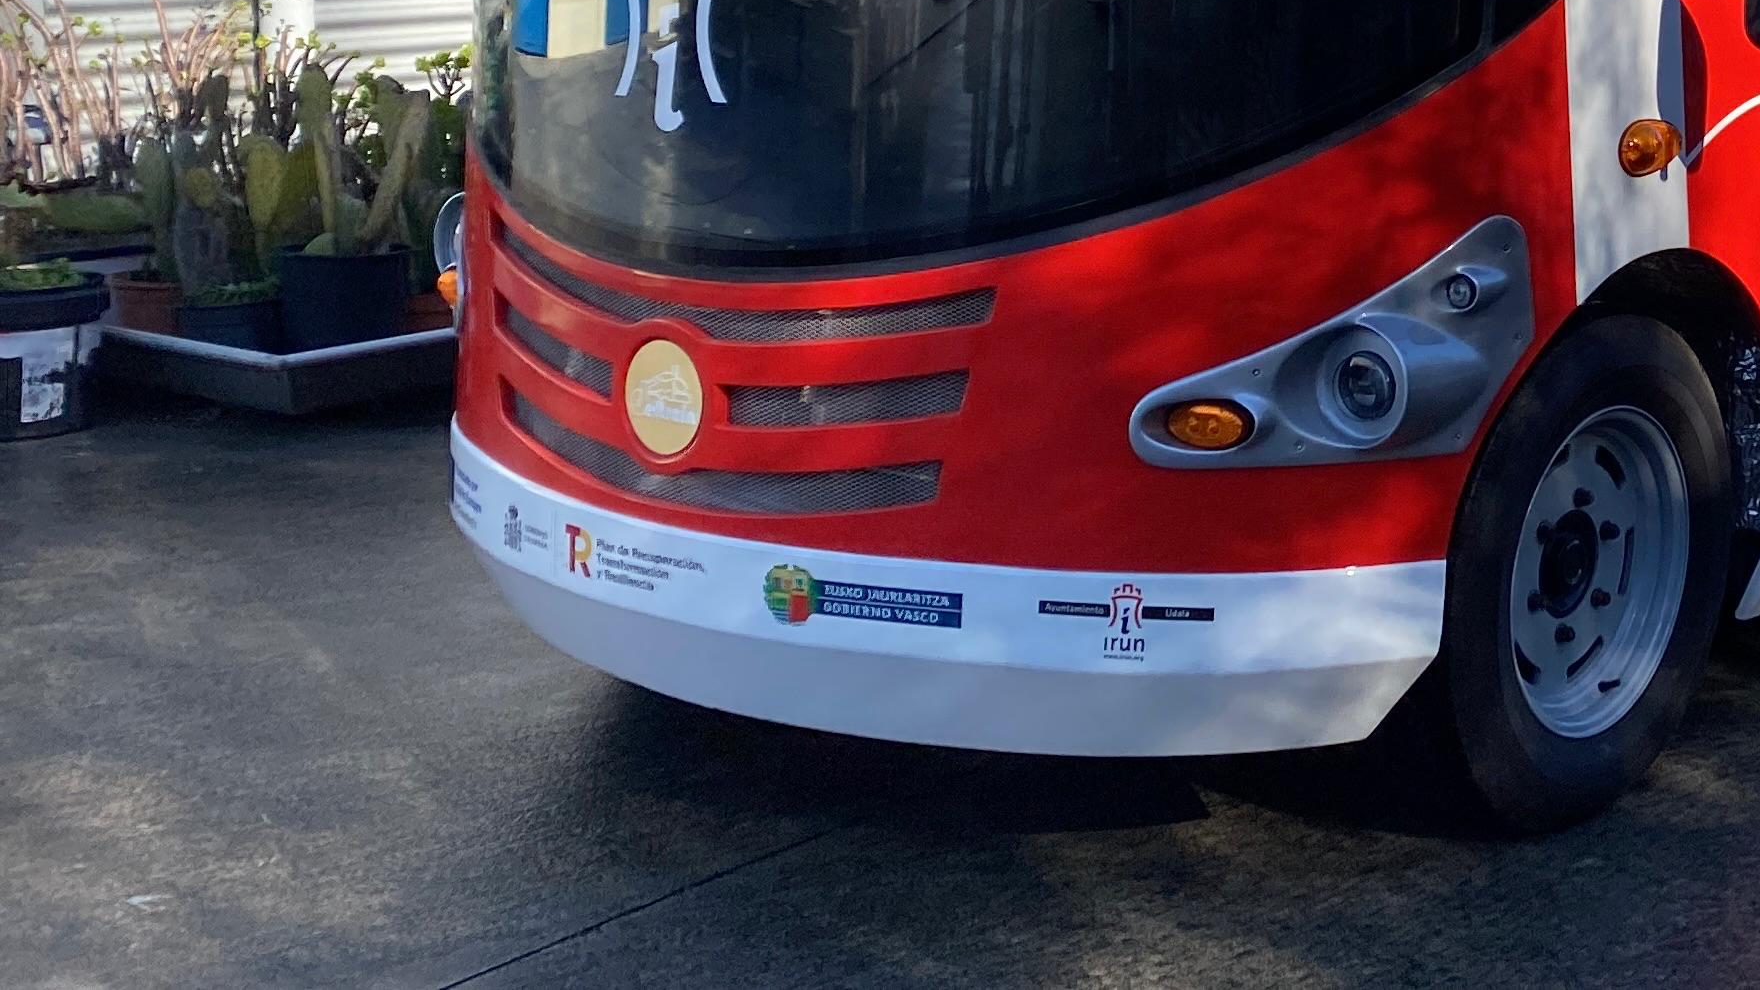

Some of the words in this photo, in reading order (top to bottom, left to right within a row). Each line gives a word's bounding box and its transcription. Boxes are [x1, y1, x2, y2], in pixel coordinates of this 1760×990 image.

[824, 584, 863, 598] EUSKO
[866, 589, 950, 607] JAURLARITZA
[823, 602, 891, 619] GOBIERNO
[895, 609, 939, 623] VASCO
[1045, 602, 1105, 615] Ayuntamiento
[1165, 609, 1190, 618] Udala
